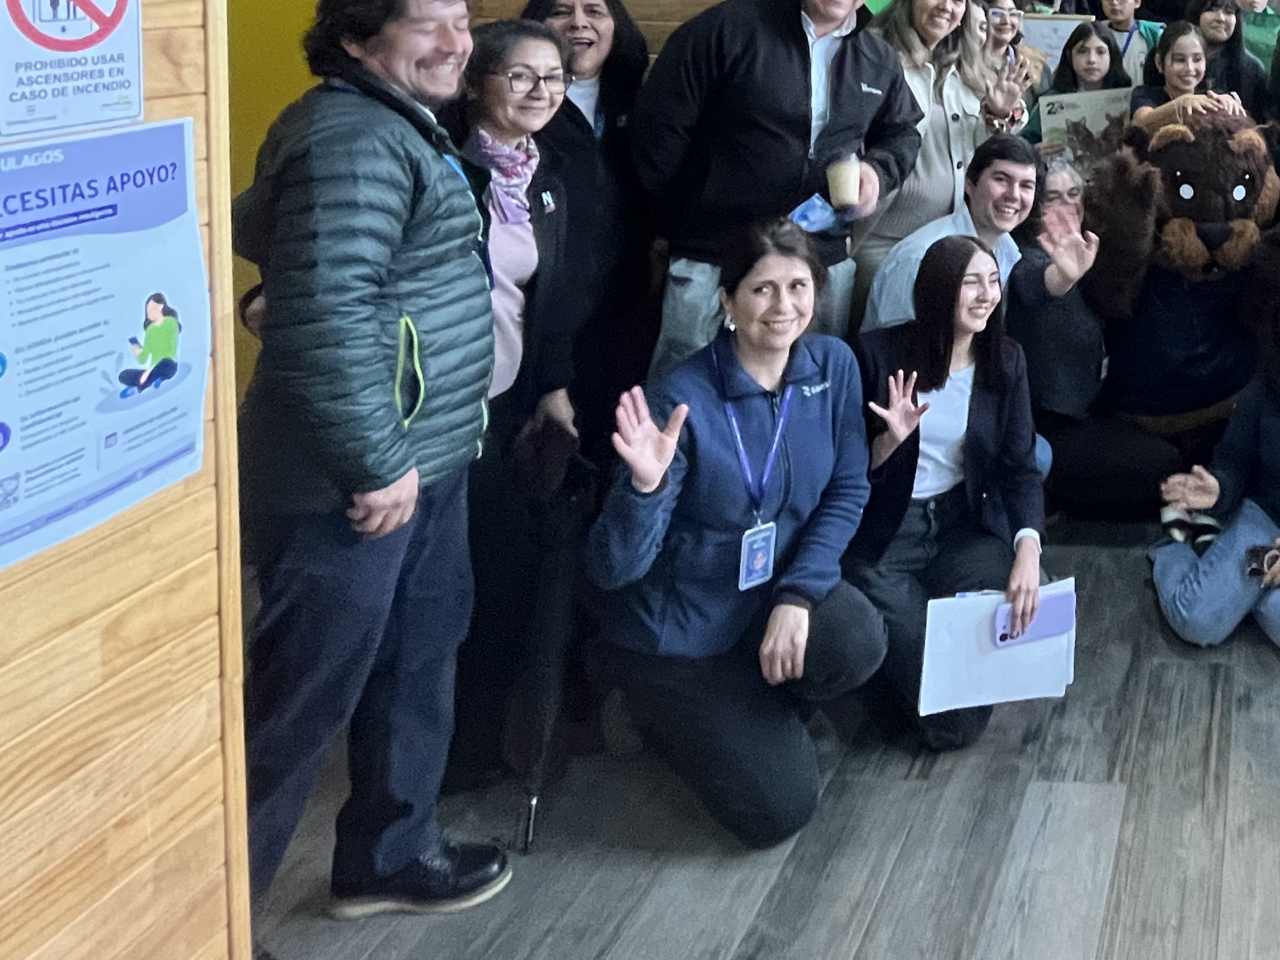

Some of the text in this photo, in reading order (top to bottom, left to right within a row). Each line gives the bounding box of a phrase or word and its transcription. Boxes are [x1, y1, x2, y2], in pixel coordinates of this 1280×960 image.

[15, 53, 125, 73] PROHIBIDO USAR
[16, 67, 125, 88] ASCENSORES EN
[9, 79, 131, 103] CASO DE INCENDIO
[0, 149, 65, 171] ULAGOS
[0, 162, 178, 218] CESITAS APOYO?
